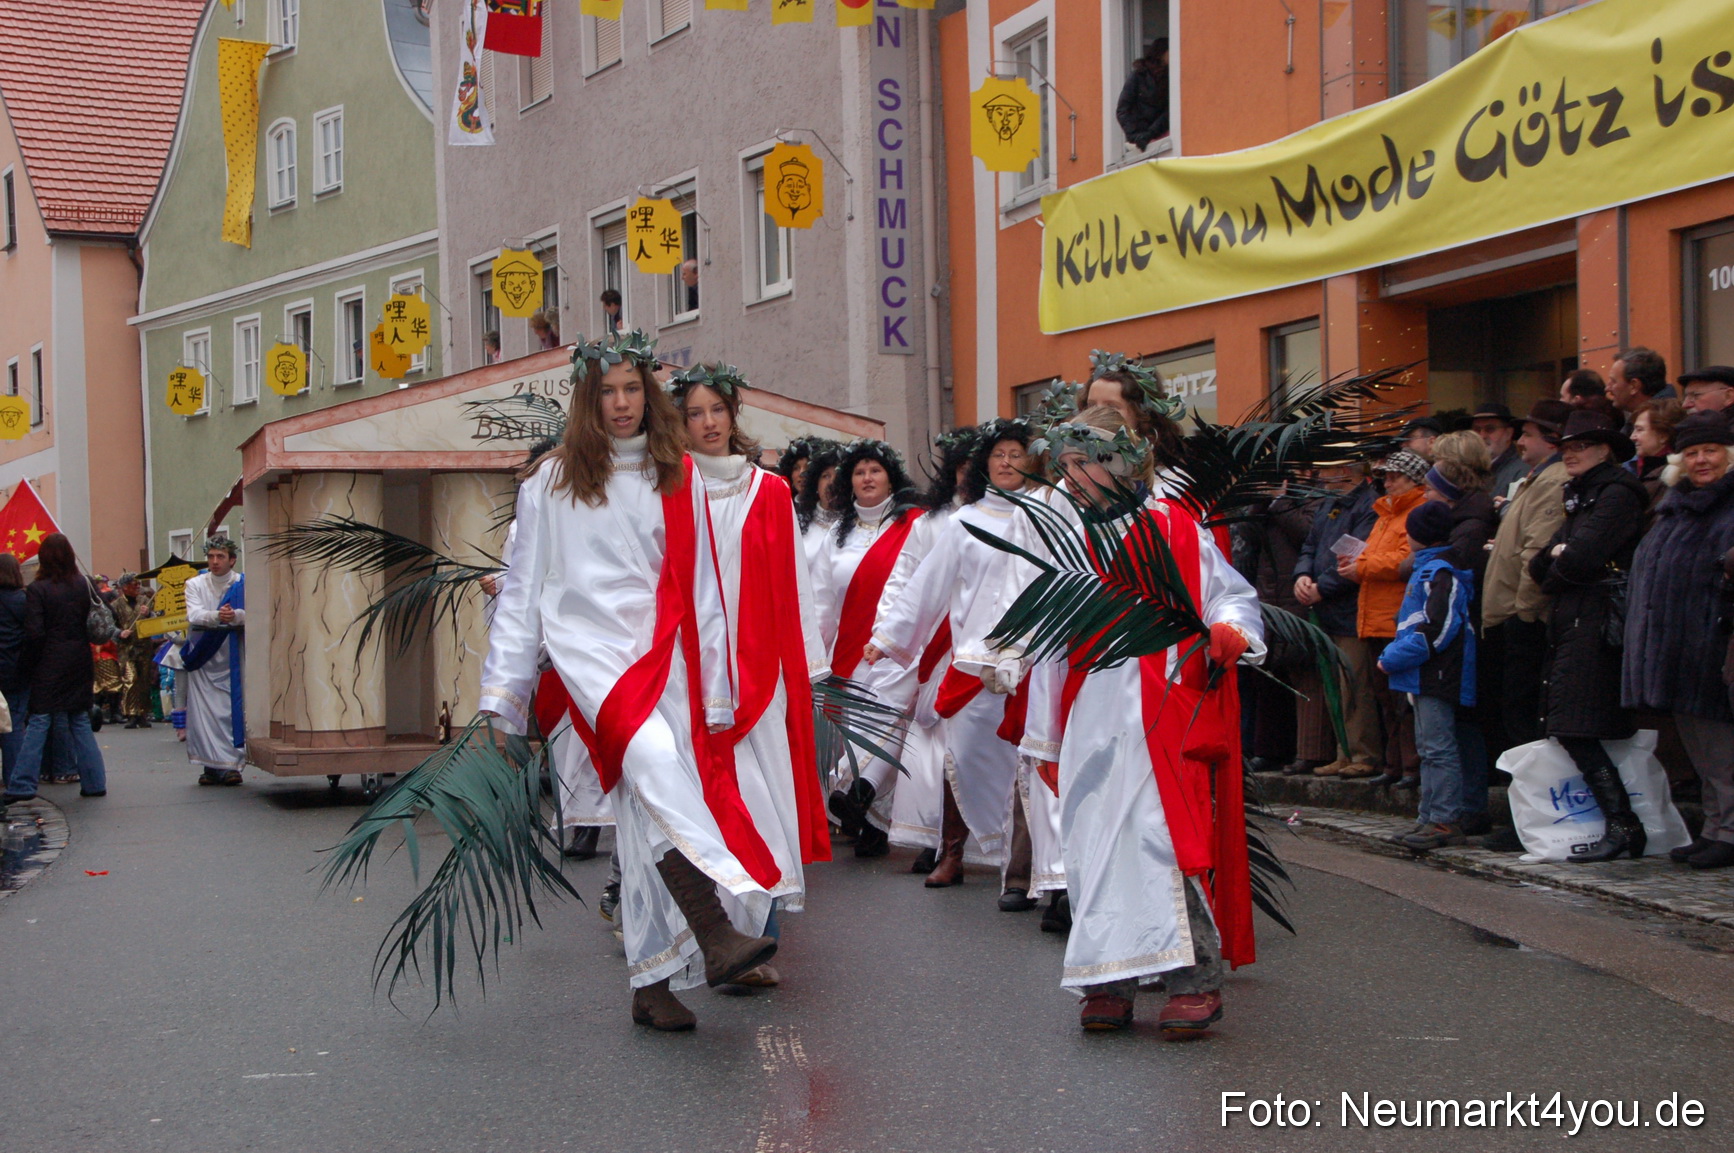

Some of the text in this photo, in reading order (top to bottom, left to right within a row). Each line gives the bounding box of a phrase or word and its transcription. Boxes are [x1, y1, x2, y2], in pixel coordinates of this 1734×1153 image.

[877, 78, 909, 348] SCHMUCK
[1055, 196, 1268, 290] Kille-Wau
[1270, 133, 1436, 237] Mode
[1455, 76, 1631, 184] Götz
[513, 379, 571, 398] ZEUS
